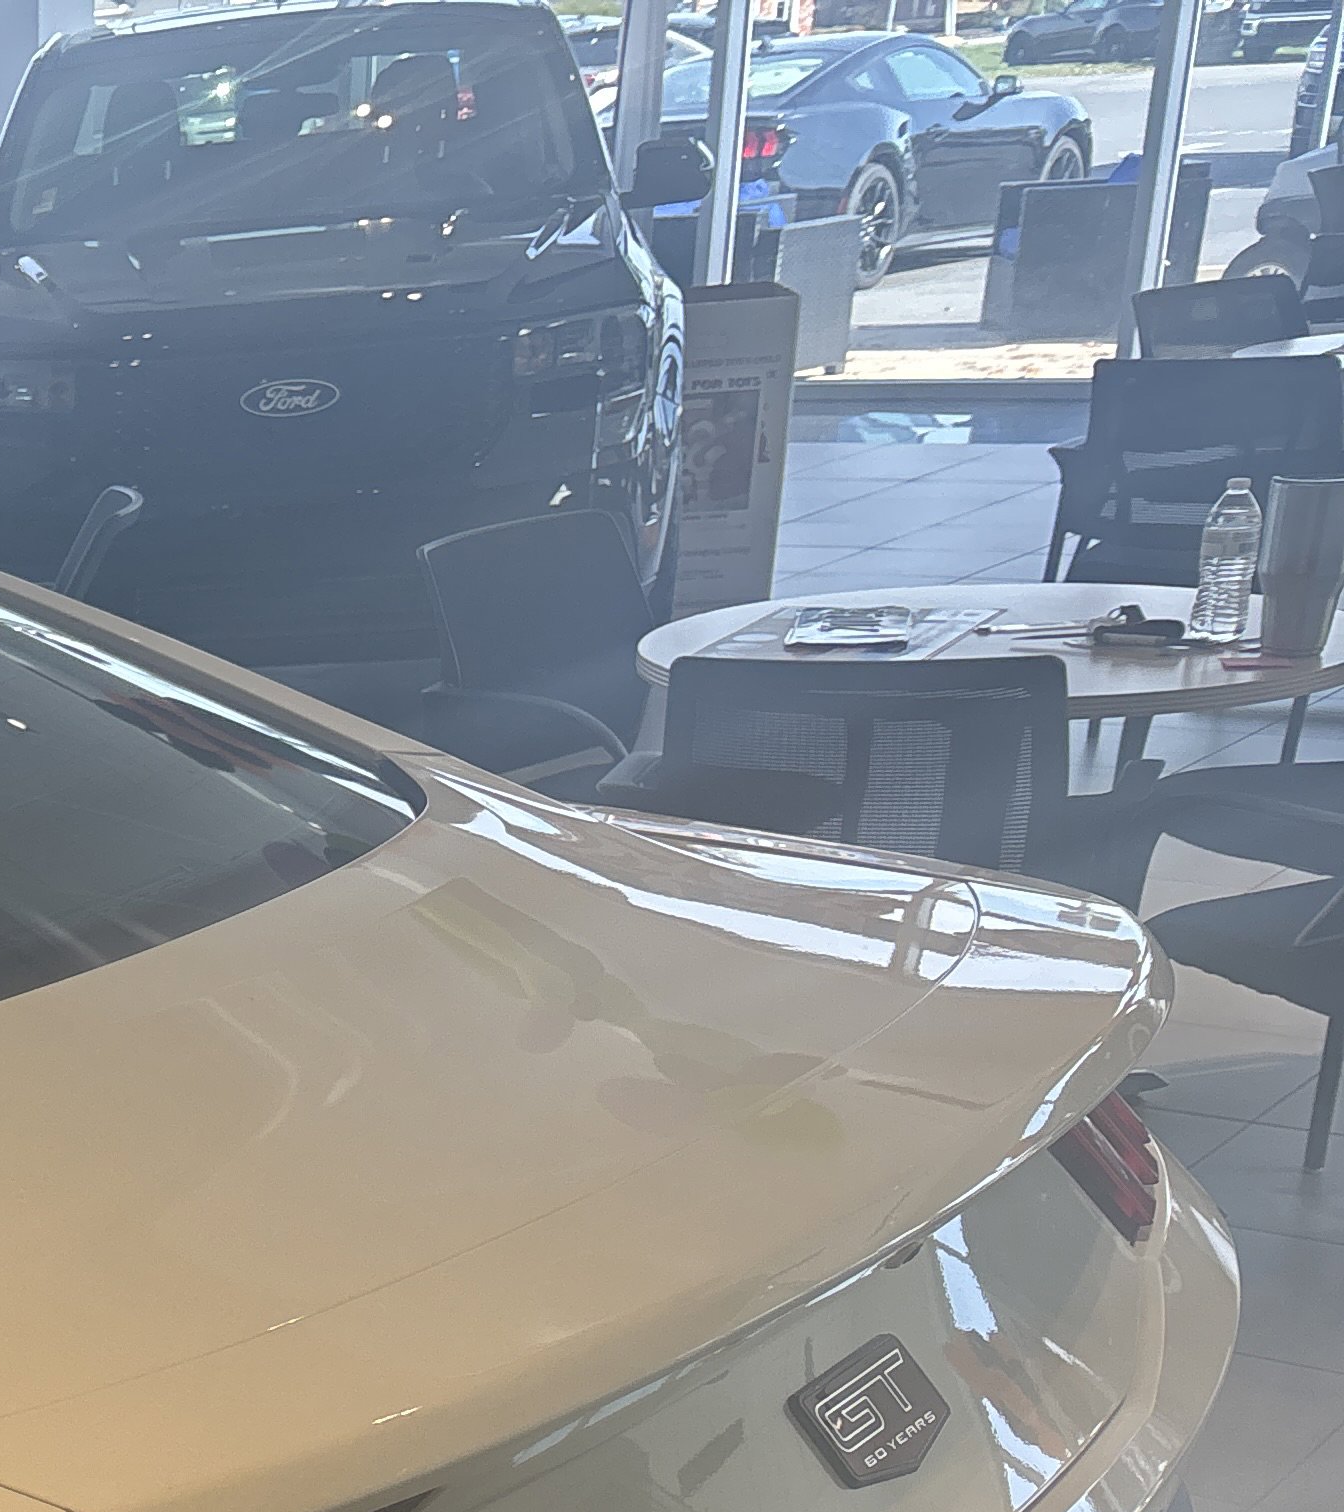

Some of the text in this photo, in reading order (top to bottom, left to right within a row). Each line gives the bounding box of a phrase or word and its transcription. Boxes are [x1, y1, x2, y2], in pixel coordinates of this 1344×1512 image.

[259, 385, 321, 412] Ford
[814, 1348, 913, 1453] GT
[864, 1410, 937, 1468] 60 YEARS
